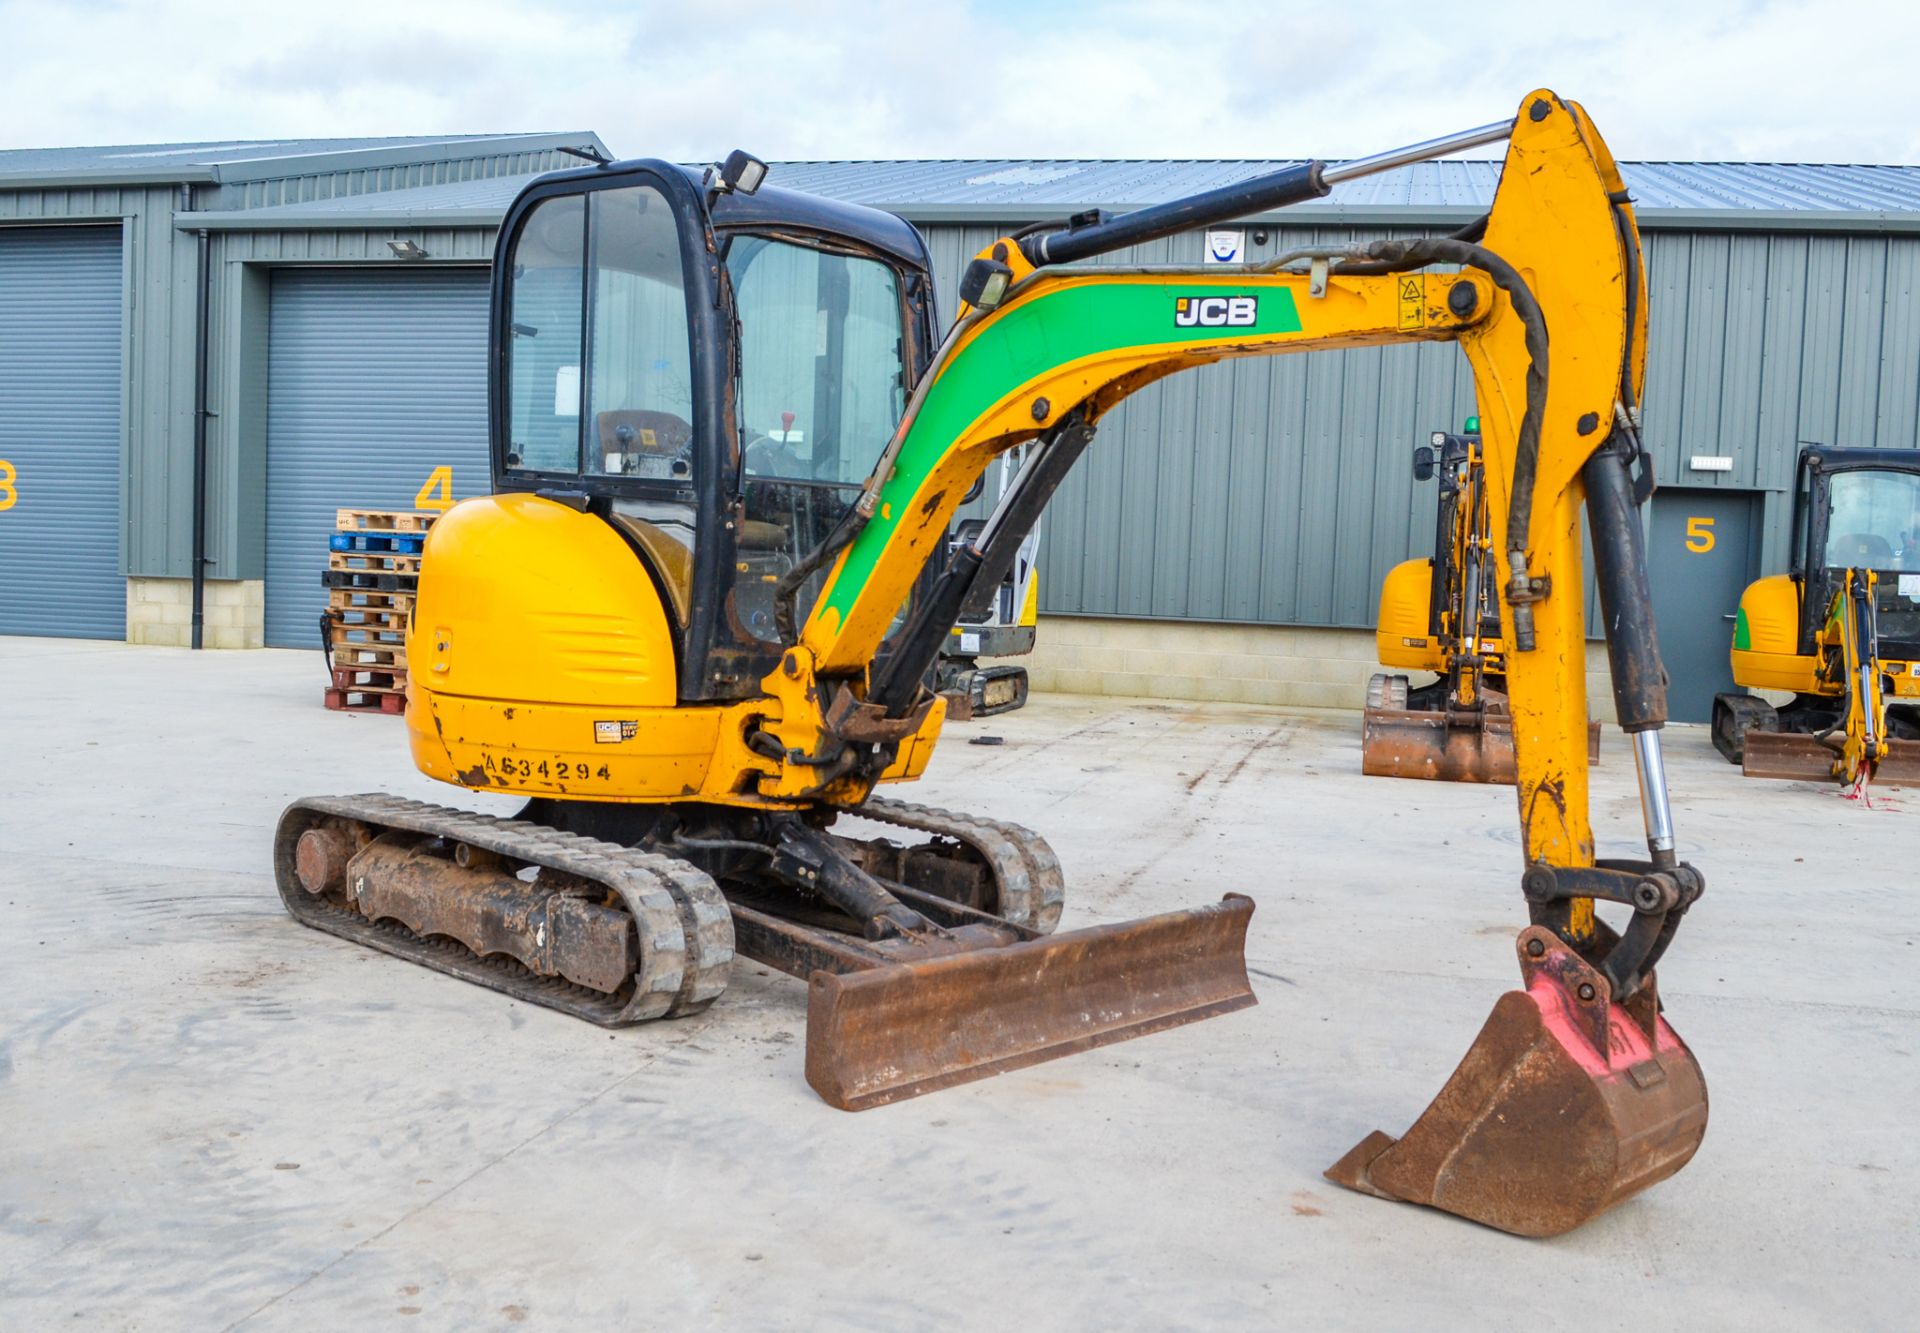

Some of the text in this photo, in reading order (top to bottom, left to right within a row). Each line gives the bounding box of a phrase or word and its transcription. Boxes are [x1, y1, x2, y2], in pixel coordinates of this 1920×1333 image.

[1176, 298, 1256, 326] JCB
[415, 465, 456, 513] 4
[1685, 517, 1715, 553] 5
[485, 754, 611, 780] A634294
